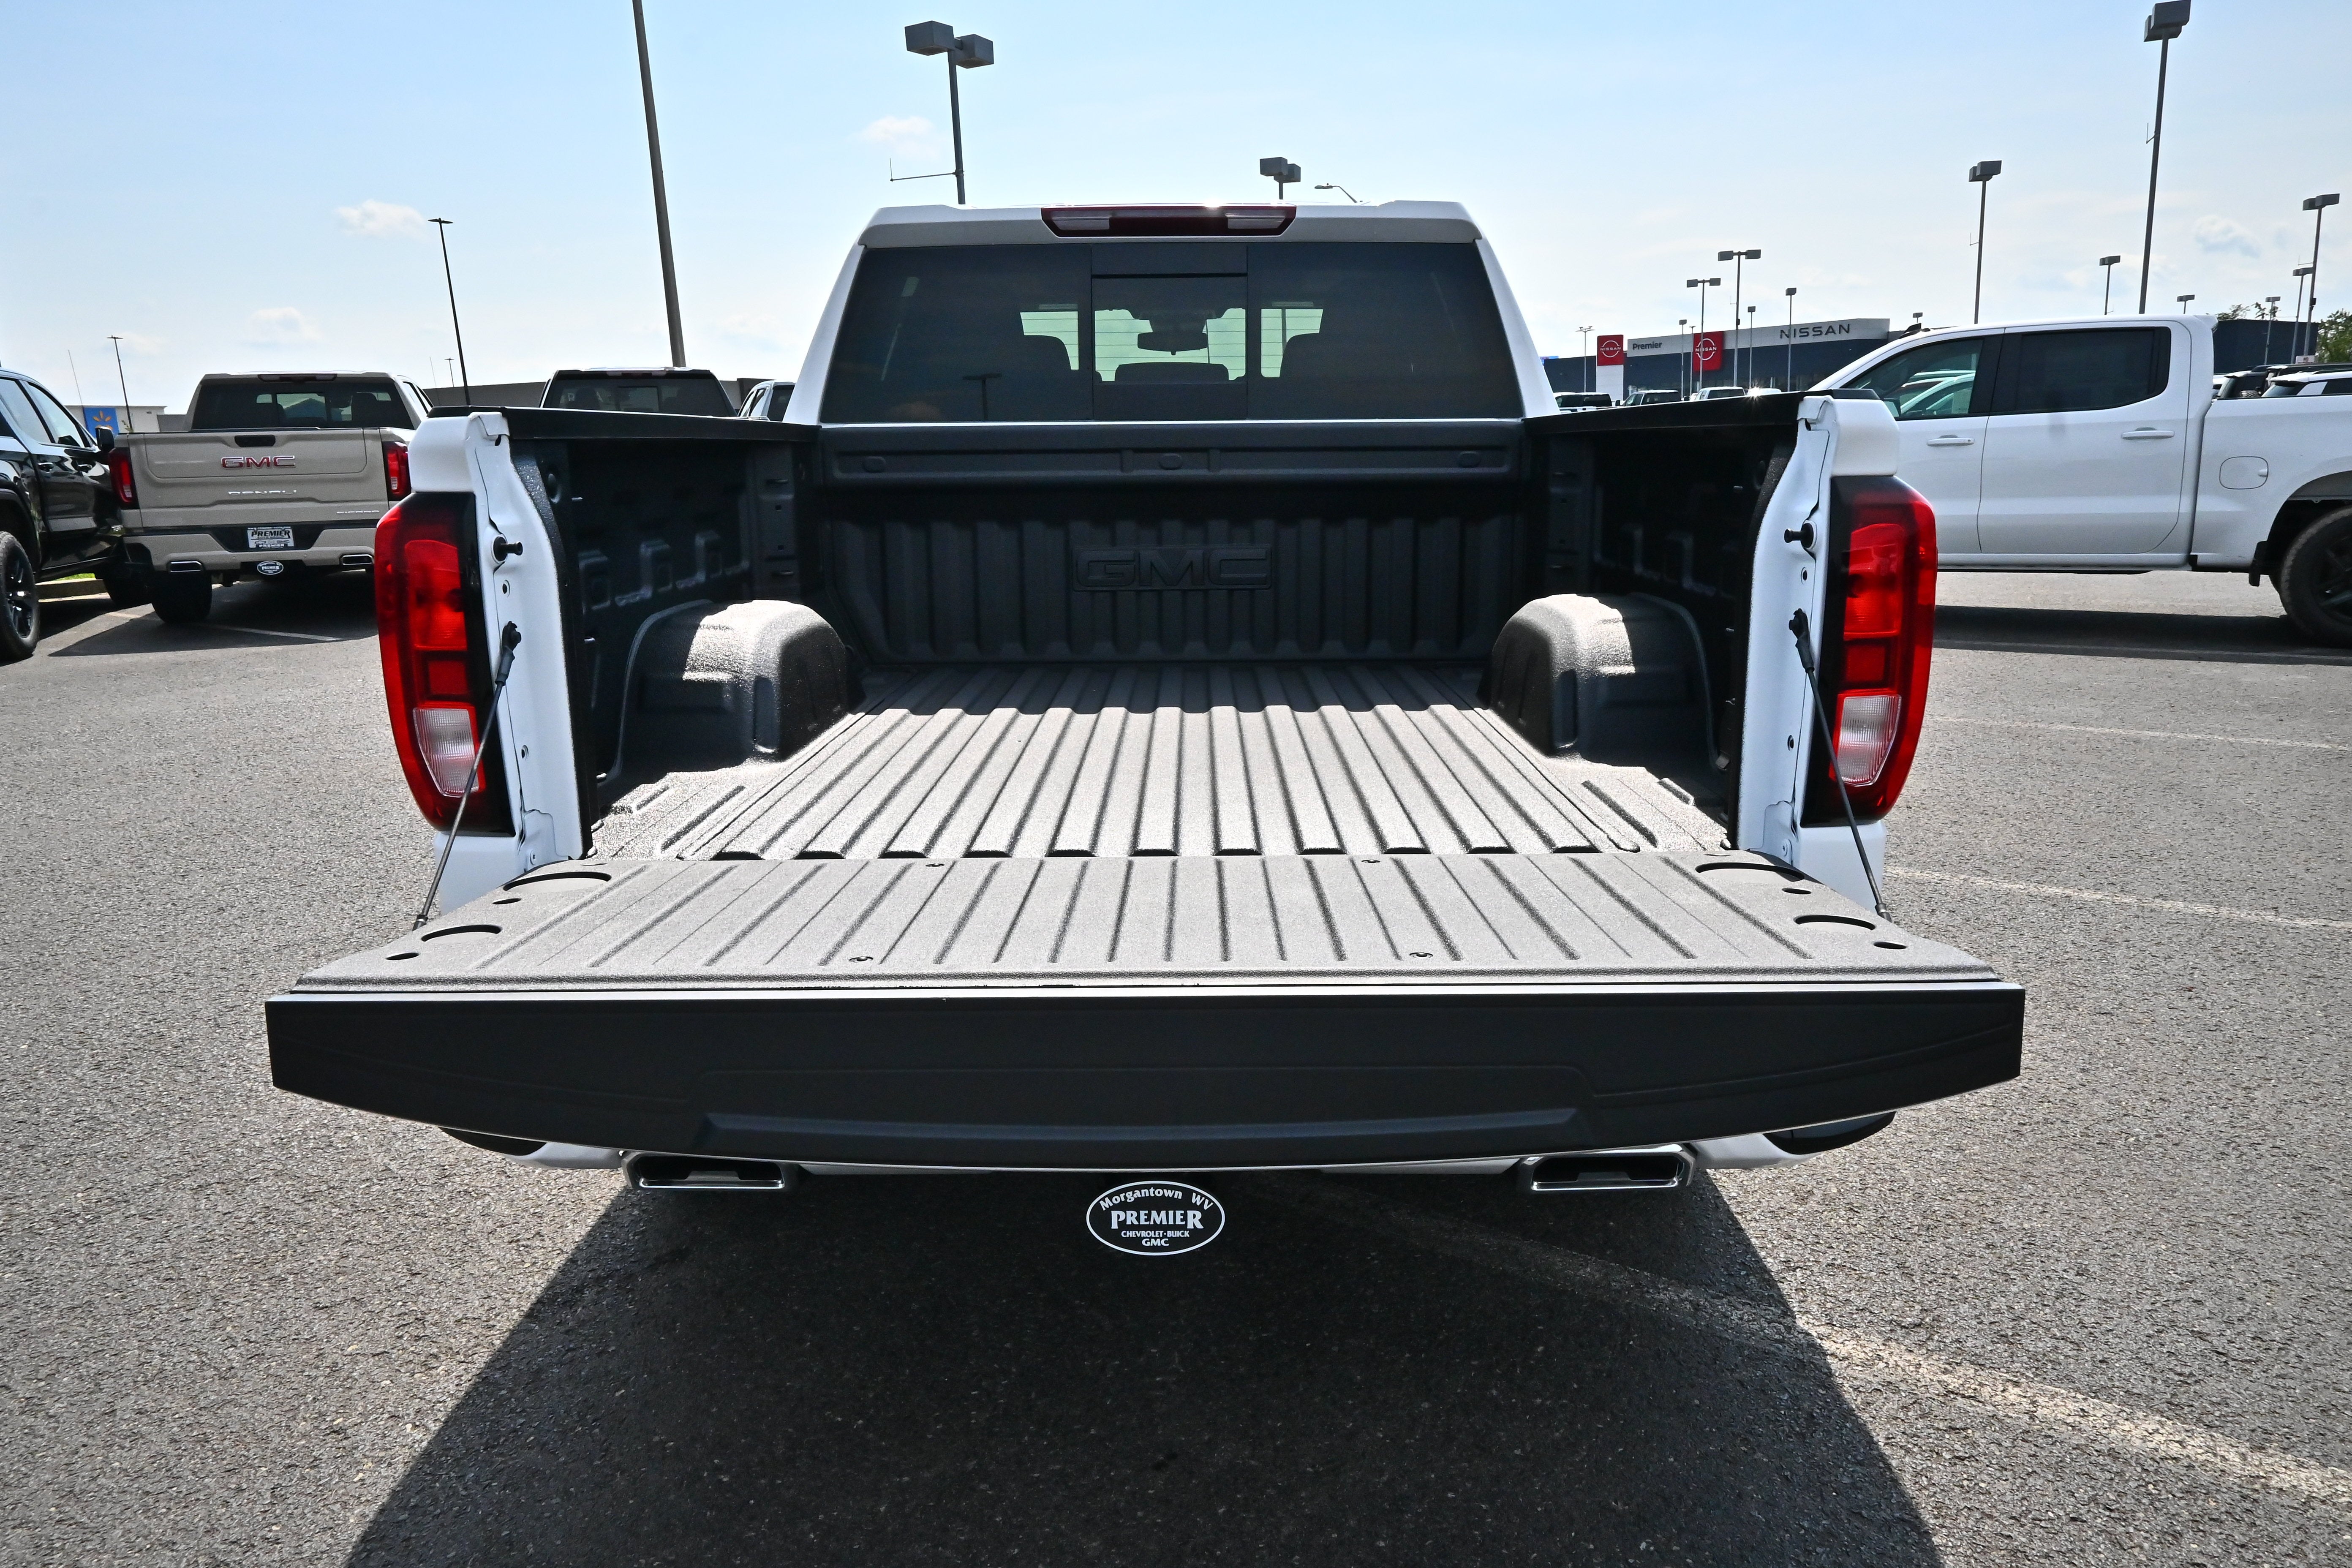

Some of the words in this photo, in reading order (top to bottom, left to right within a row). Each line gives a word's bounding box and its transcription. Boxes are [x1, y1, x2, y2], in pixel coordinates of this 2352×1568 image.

[1780, 324, 1850, 339] NISSAN
[1632, 342, 1663, 350] Premier
[221, 455, 296, 469] GMC
[251, 530, 291, 539] PREMIER
[1076, 549, 1268, 587] GMC
[1099, 1187, 1182, 1211] Morgantown
[1191, 1192, 1214, 1211] WV
[1111, 1210, 1204, 1229] PREMIER
[1142, 1238, 1170, 1246] GMC
